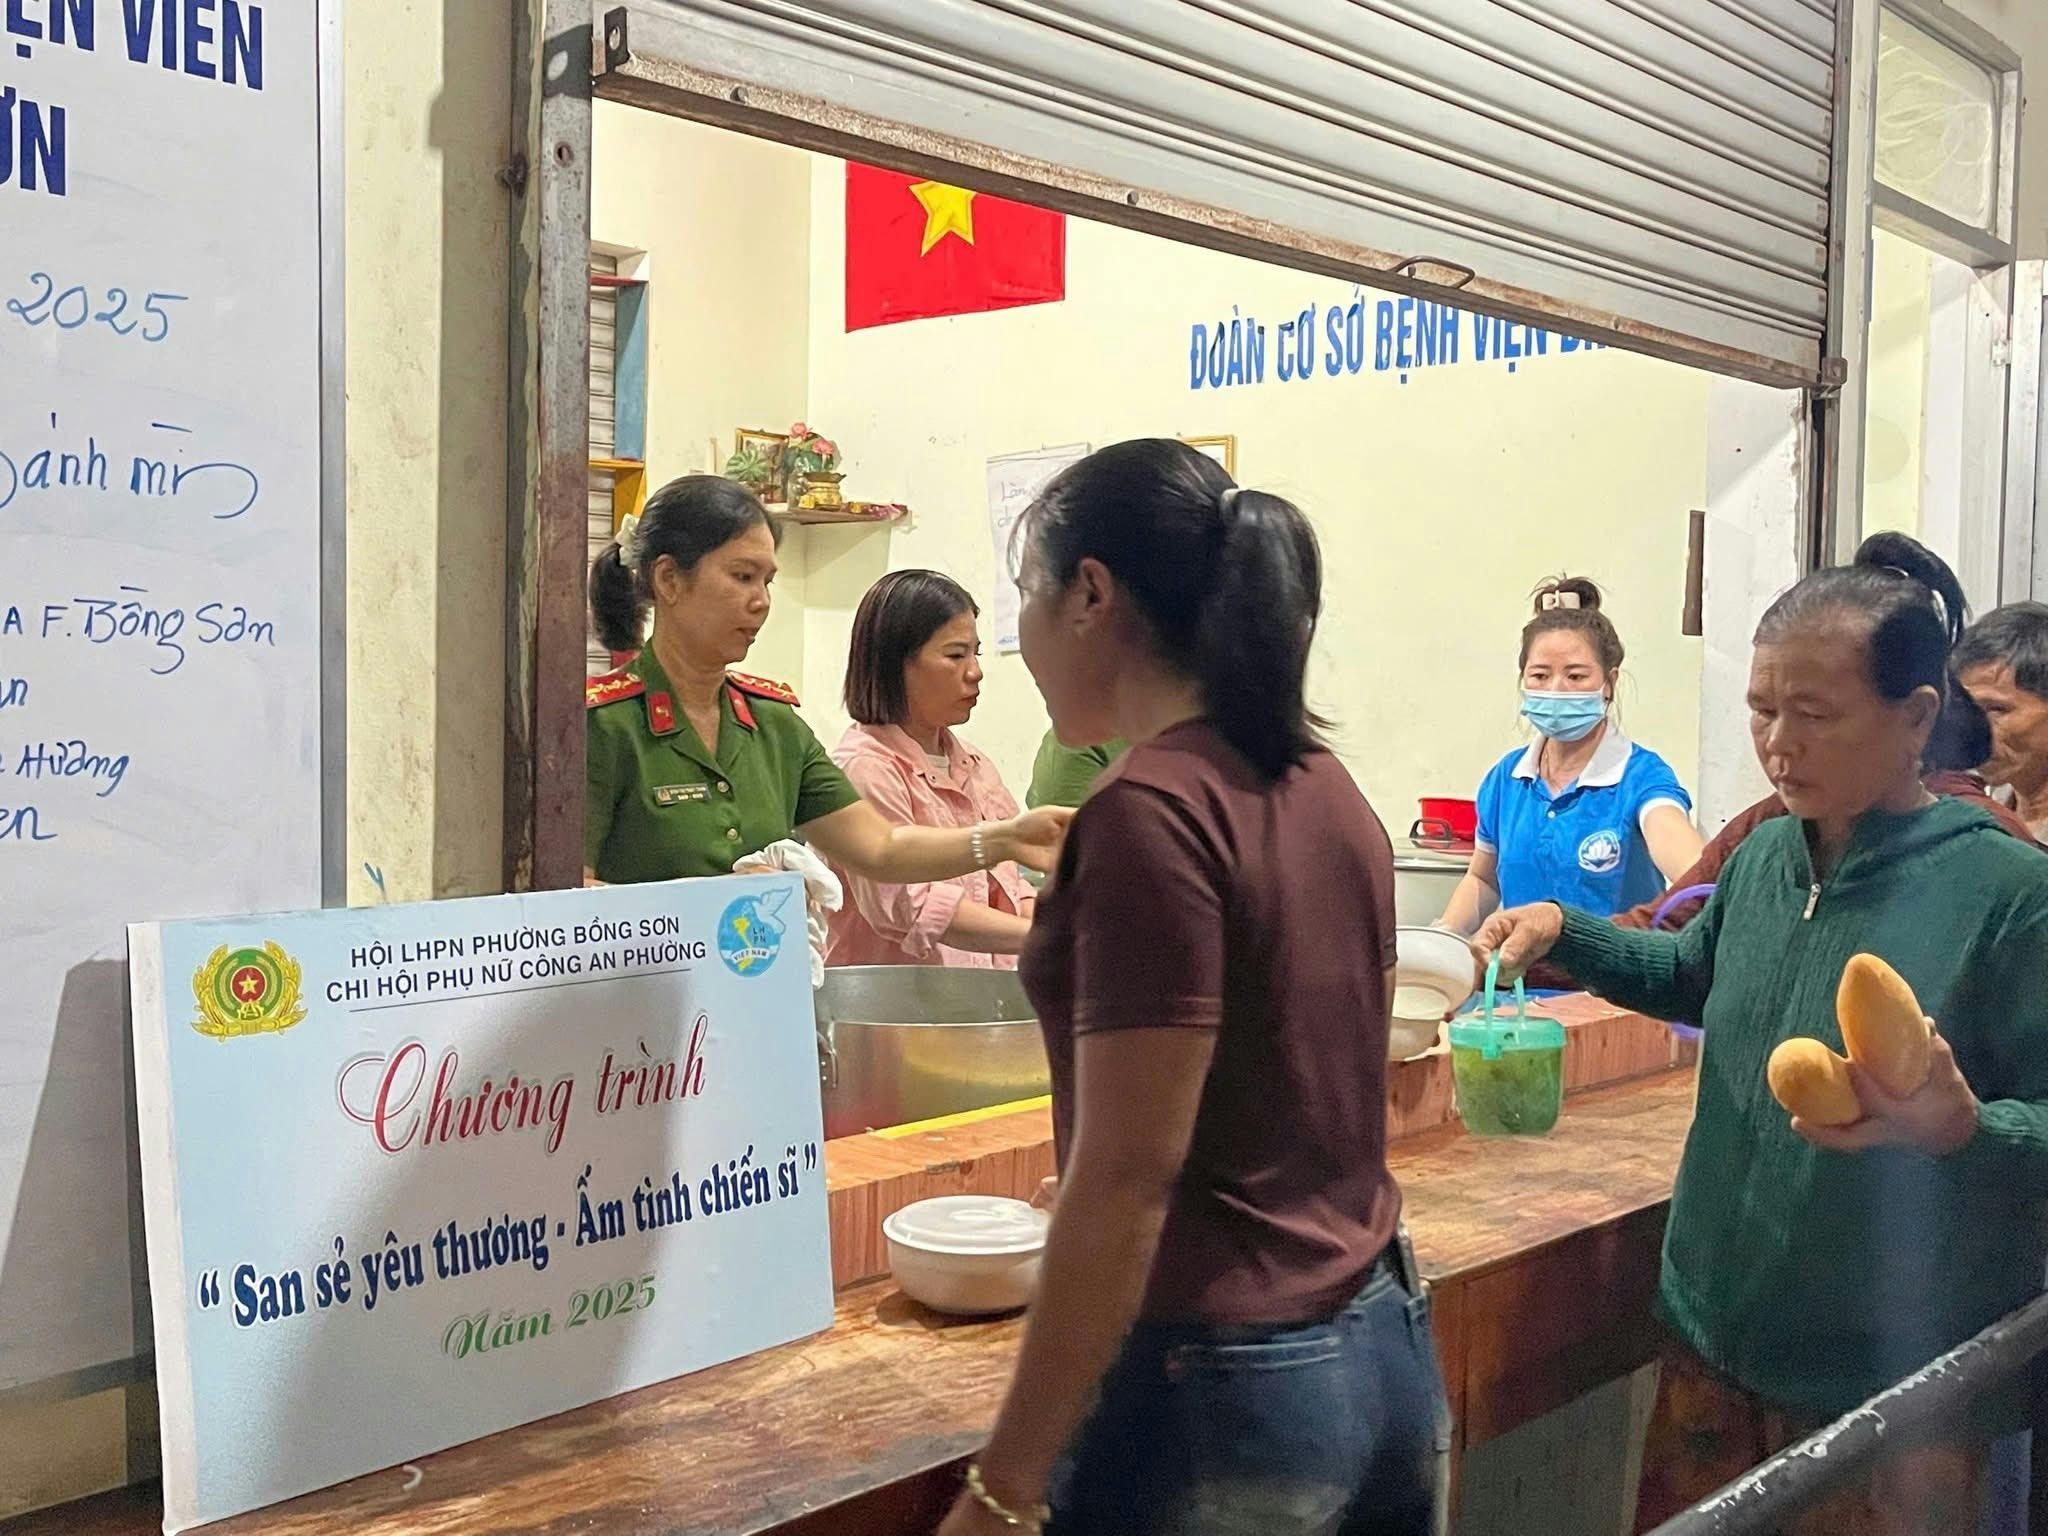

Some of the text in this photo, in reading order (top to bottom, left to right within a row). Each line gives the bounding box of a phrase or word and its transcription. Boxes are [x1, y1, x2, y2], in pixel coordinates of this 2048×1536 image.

[7, 272, 188, 341] 2025
[1190, 304, 1264, 389] ĐOÀN
[1277, 302, 1316, 382] CƠ
[0, 412, 107, 509] ánh
[326, 940, 706, 1002] CHI HỘI PHỤ NỮ CÔNG AN PHƯỜNG
[351, 915, 680, 970] HỘI LHPN PHƯỜNG BỒNG SƠN
[339, 1013, 709, 1154] Chương trình
[234, 1264, 306, 1327] San
[315, 1235, 351, 1308] sẻ
[361, 1230, 425, 1310] yêu
[432, 1213, 549, 1279] thương
[575, 1164, 626, 1247] Ấm
[632, 1171, 692, 1232] tình
[699, 1144, 771, 1216] chiến
[777, 1145, 799, 1198] sĩ
[443, 1274, 656, 1359] Năm 2025
